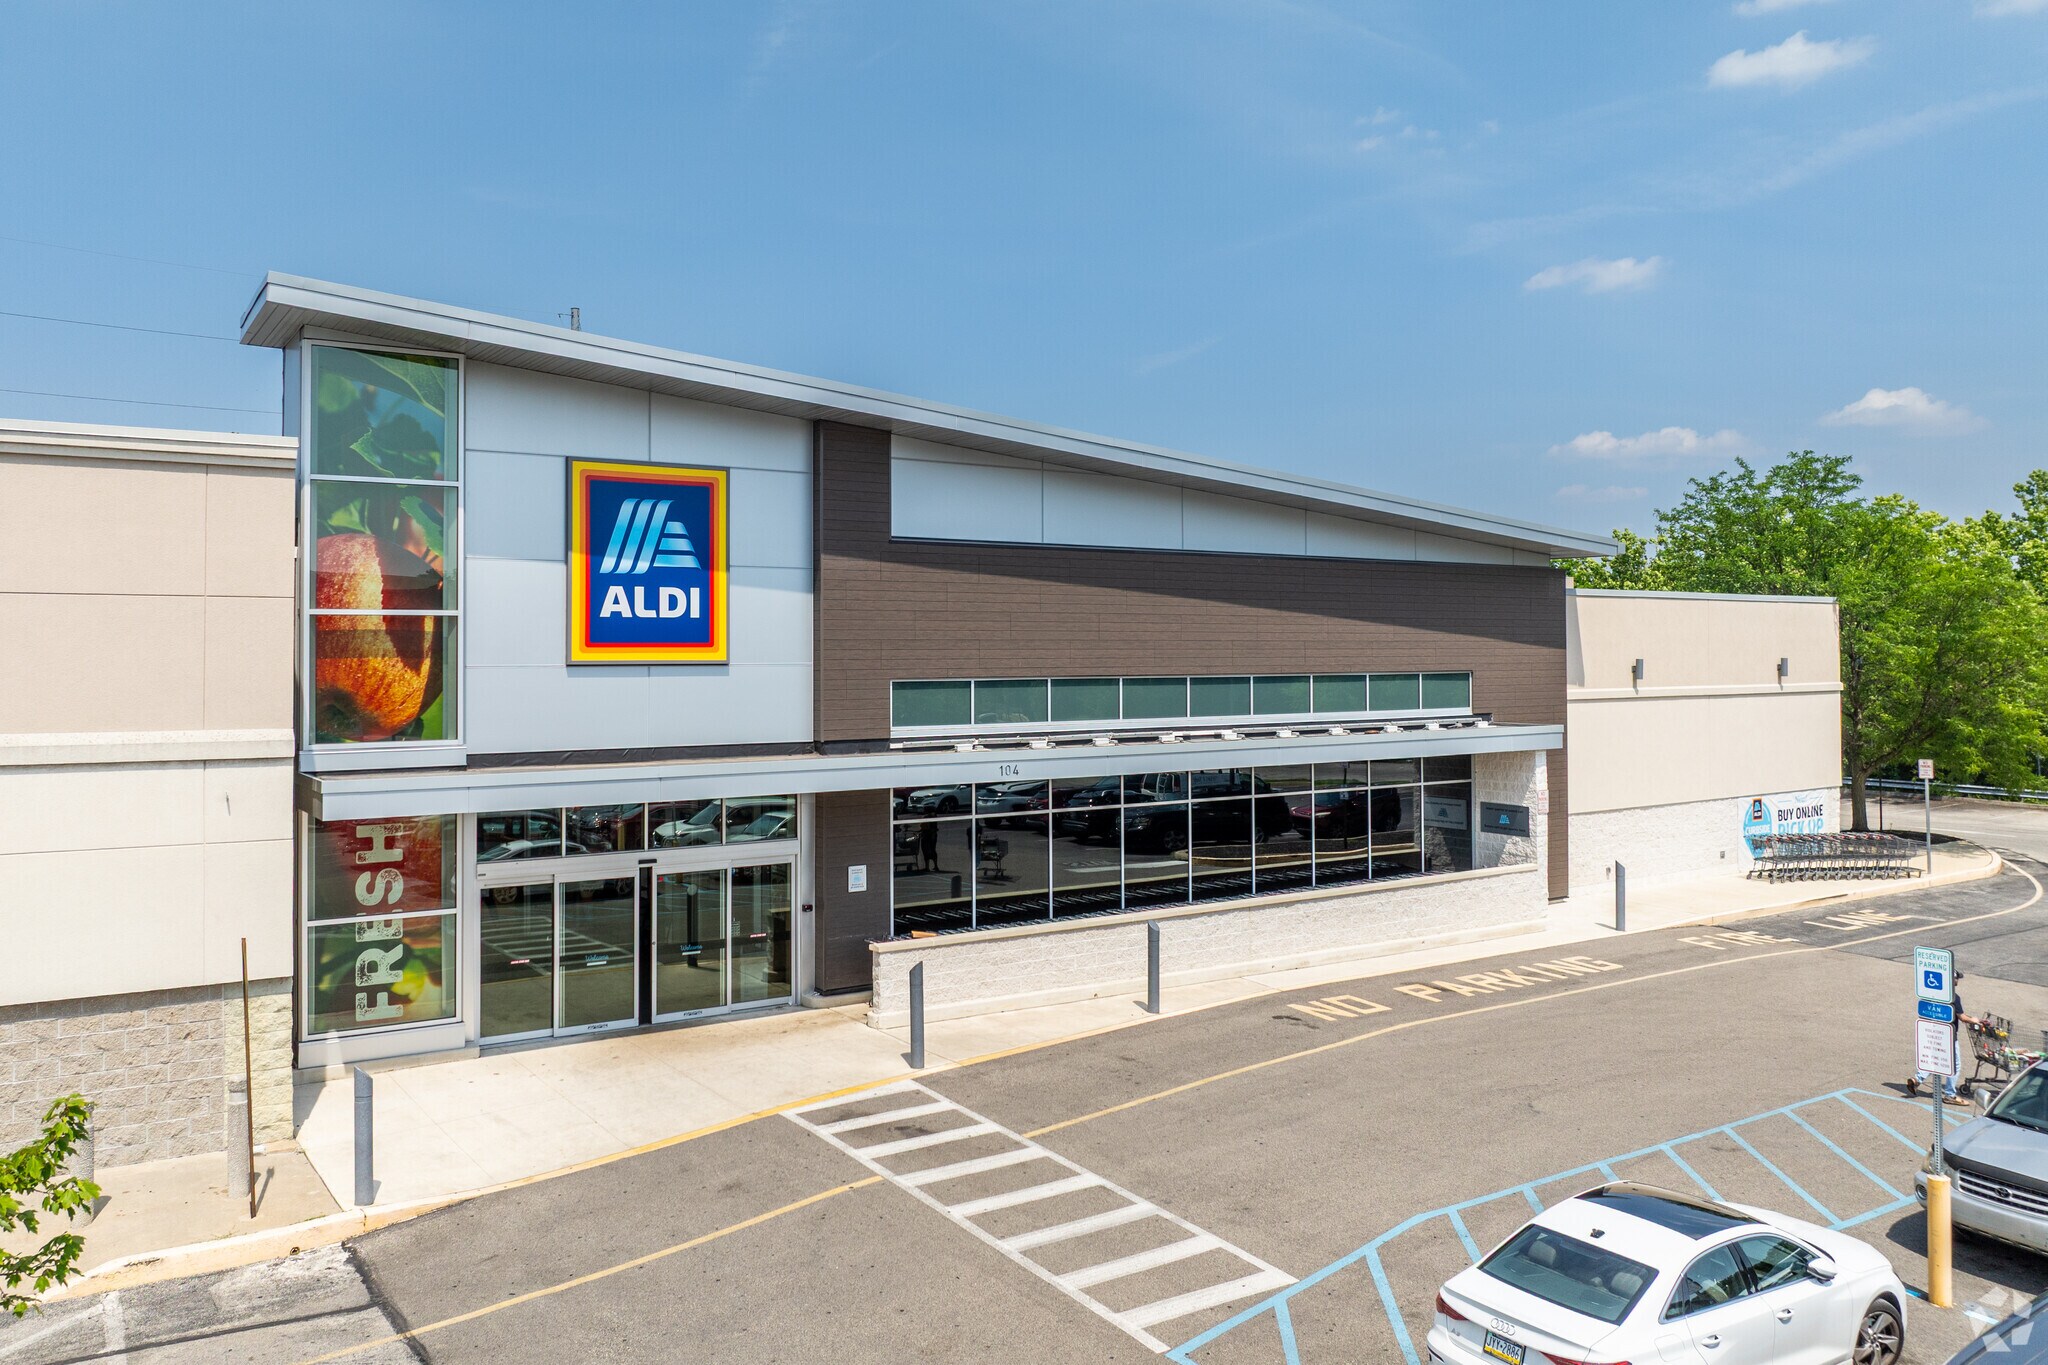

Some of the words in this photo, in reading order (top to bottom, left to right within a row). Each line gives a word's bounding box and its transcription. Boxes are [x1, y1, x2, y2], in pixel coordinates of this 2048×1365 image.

[599, 585, 700, 619] ALDI
[999, 764, 1019, 777] 104
[1777, 809, 1794, 821] BUY
[1796, 804, 1823, 819] ONLINE
[355, 823, 403, 1022] FRESH
[1918, 952, 1948, 962] RESERVED
[1287, 995, 1392, 1021] NO
[1393, 955, 1624, 1003] PARKING
[1803, 909, 1912, 931] LANE
[1919, 961, 1947, 971] PARKING
[1927, 1005, 1941, 1013] VAN
